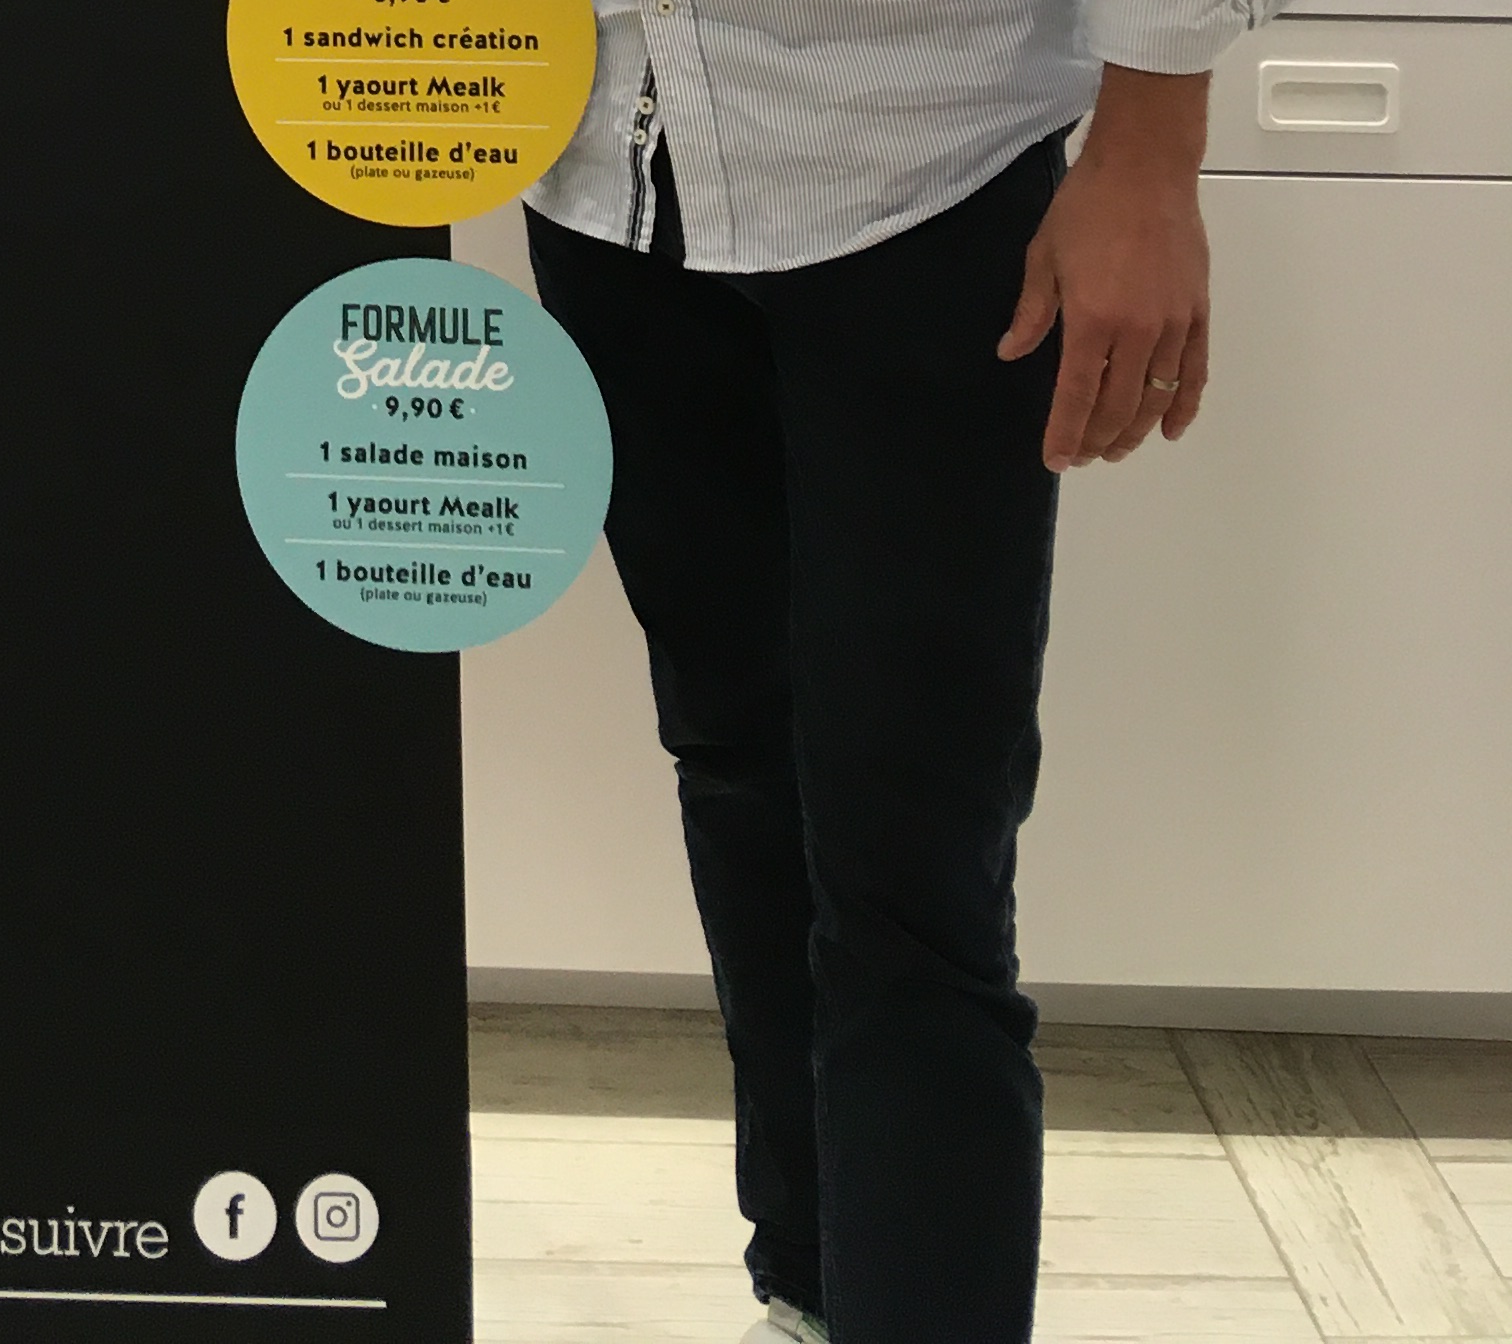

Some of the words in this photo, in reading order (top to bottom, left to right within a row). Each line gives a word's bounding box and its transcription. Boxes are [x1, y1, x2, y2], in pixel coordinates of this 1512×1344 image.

[283, 26, 294, 47] 1
[303, 26, 424, 49] sandwich
[432, 26, 540, 51] création
[317, 75, 328, 95] 1
[336, 77, 419, 100] yaourt
[427, 76, 506, 98] Mealk
[322, 101, 342, 113] ou
[347, 99, 354, 112] 1
[357, 99, 411, 113] dessert
[416, 100, 470, 113] maison
[306, 140, 317, 161] 1
[326, 140, 440, 162] bouteille
[448, 141, 519, 164] d'eau
[350, 165, 388, 180] (plate
[393, 168, 411, 179] ou
[415, 168, 476, 182] gazeuse)
[341, 303, 504, 347] FORMULE
[333, 338, 514, 400] Salade
[384, 395, 443, 422] 9,90
[449, 397, 465, 419] €
[319, 441, 331, 462] 1
[340, 442, 424, 465] salade
[433, 444, 528, 470] maison
[327, 491, 338, 512] 1
[346, 494, 431, 517] yaourt
[439, 495, 520, 519] Mealk
[333, 519, 352, 530] ou
[356, 517, 363, 530] 1
[368, 518, 423, 533] dessert
[428, 521, 483, 535] maison
[316, 560, 326, 581] 1
[336, 559, 452, 586] bouteille
[460, 564, 532, 590] d'eau
[360, 587, 400, 602] (plate
[403, 591, 422, 602] ou
[426, 592, 488, 607] gazeuse)
[0, 1205, 169, 1260] suivre
